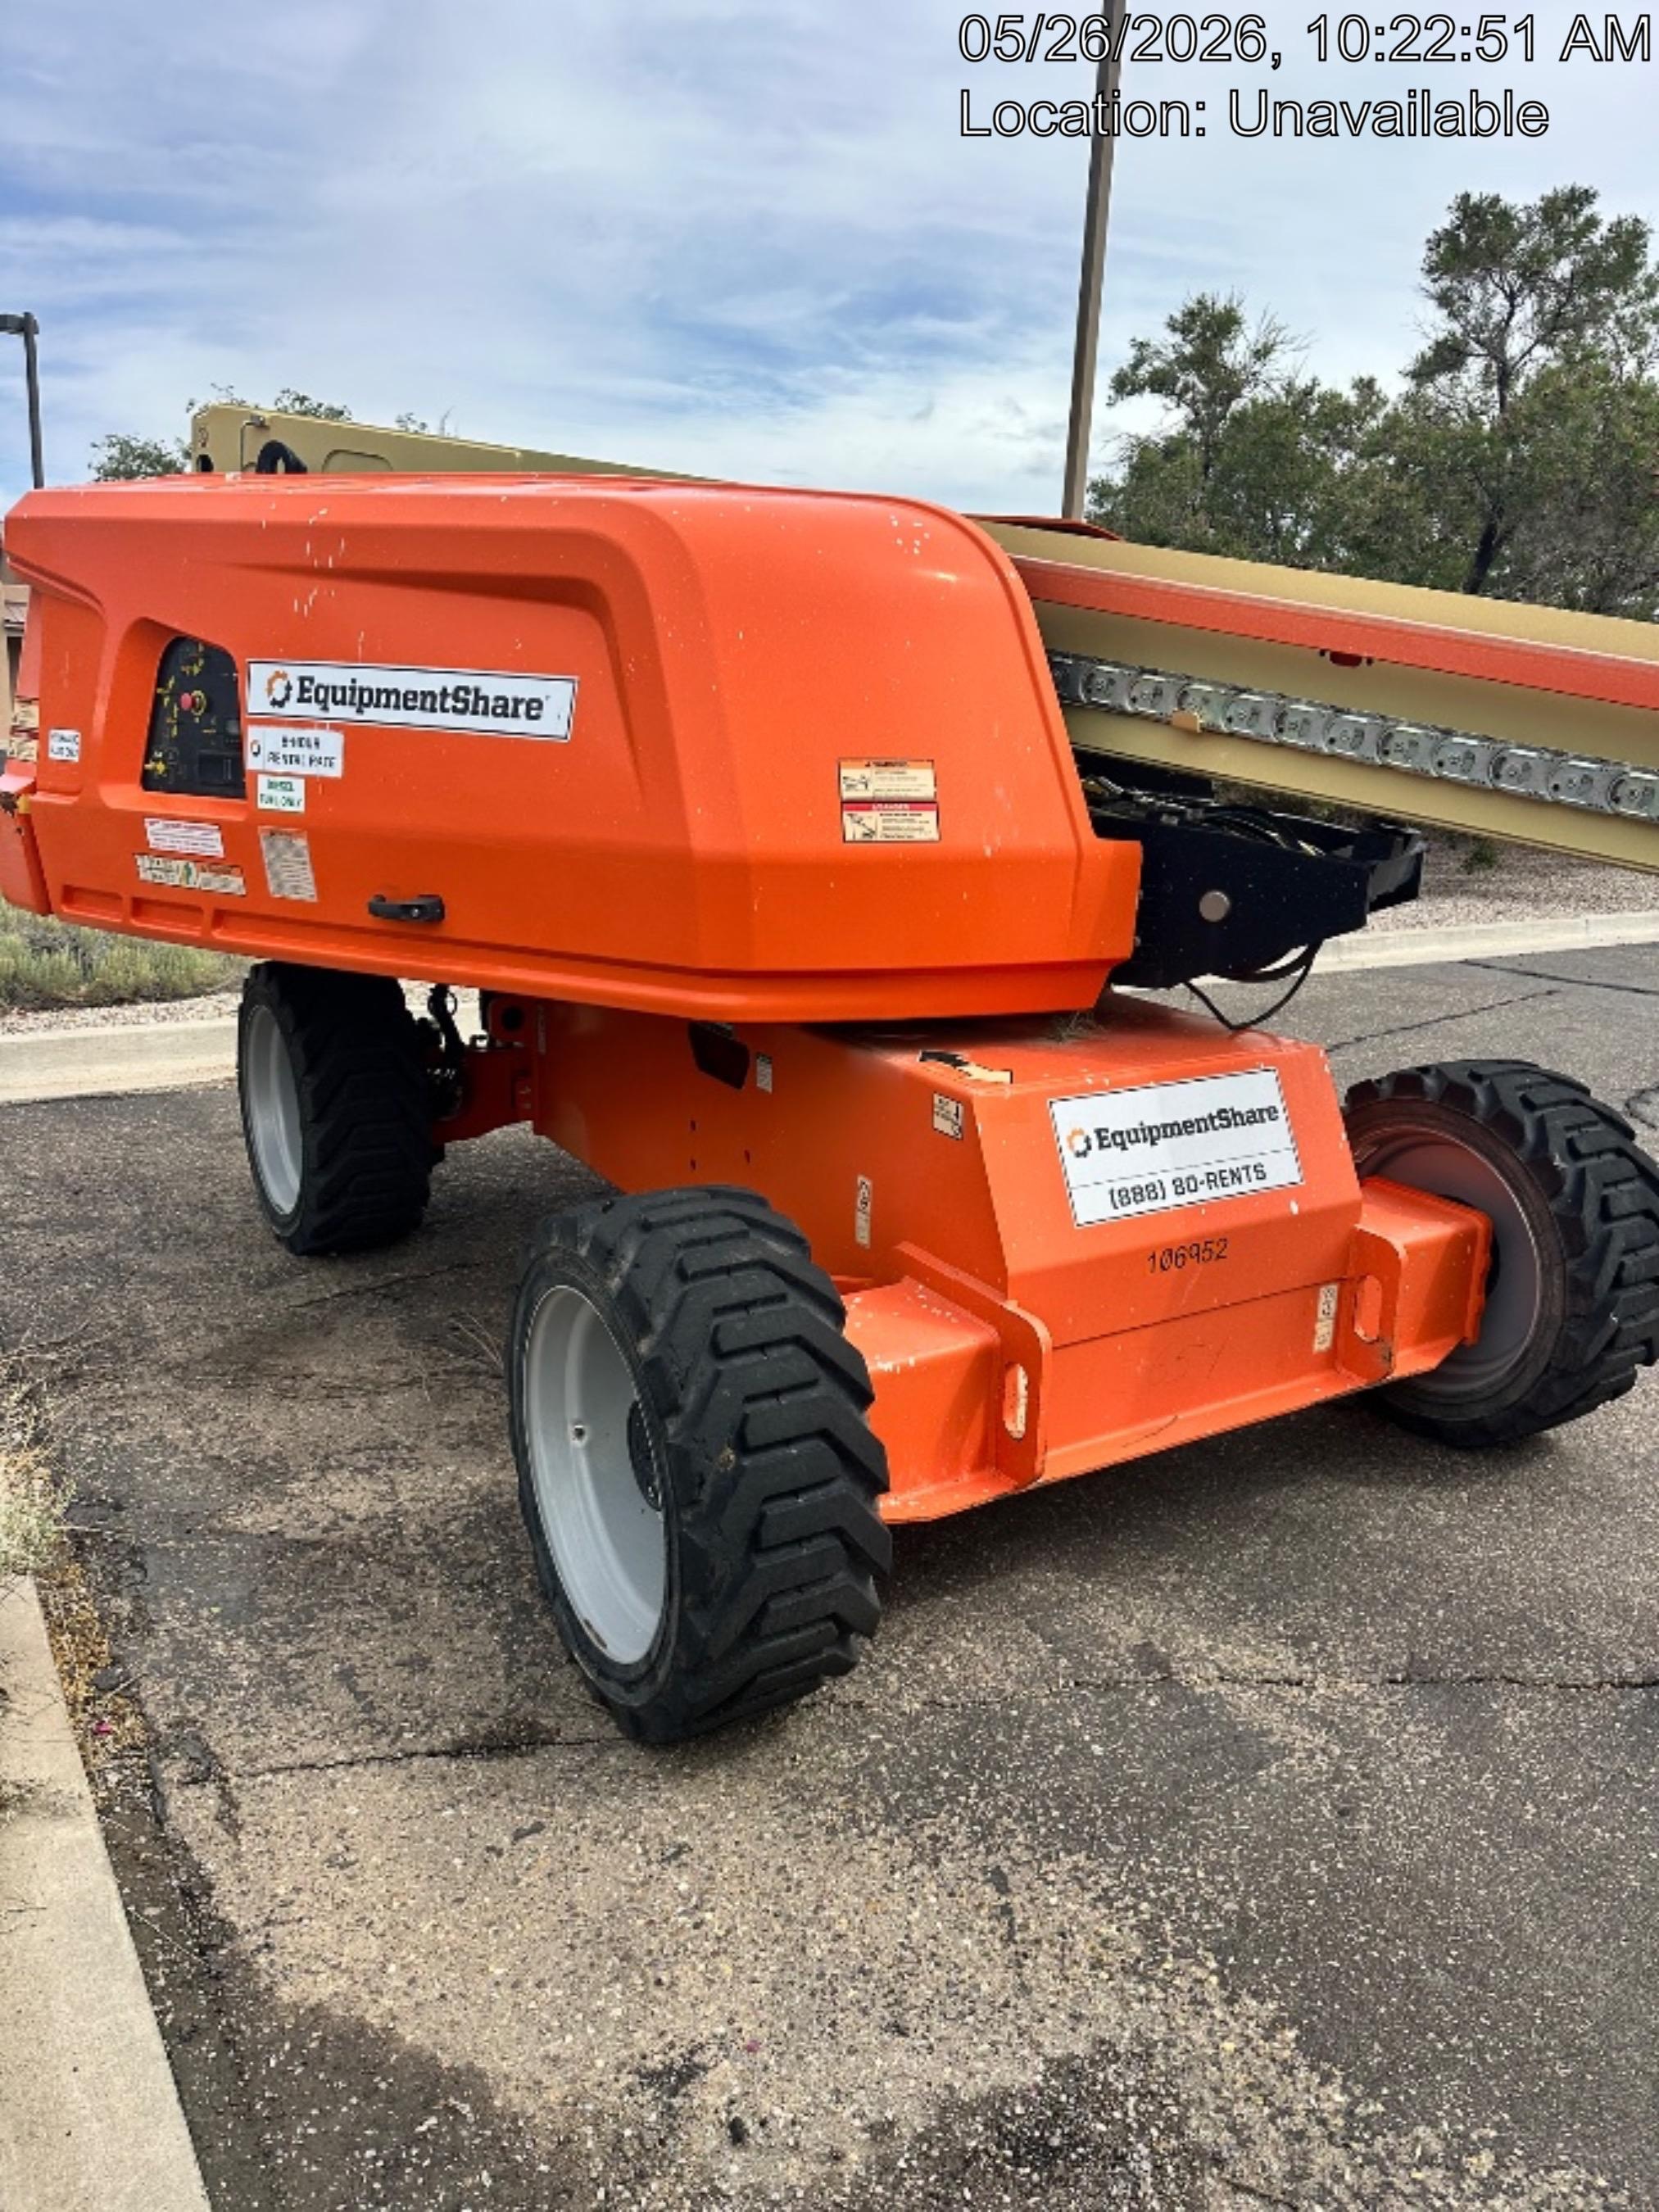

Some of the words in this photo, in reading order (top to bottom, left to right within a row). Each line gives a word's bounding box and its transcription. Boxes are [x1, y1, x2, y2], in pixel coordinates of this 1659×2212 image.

[297, 675, 544, 721] EquipmentShare
[1094, 1104, 1279, 1153] EquipmentShare
[1108, 1180, 1167, 1210] (888)
[1148, 1238, 1229, 1273] 106952
